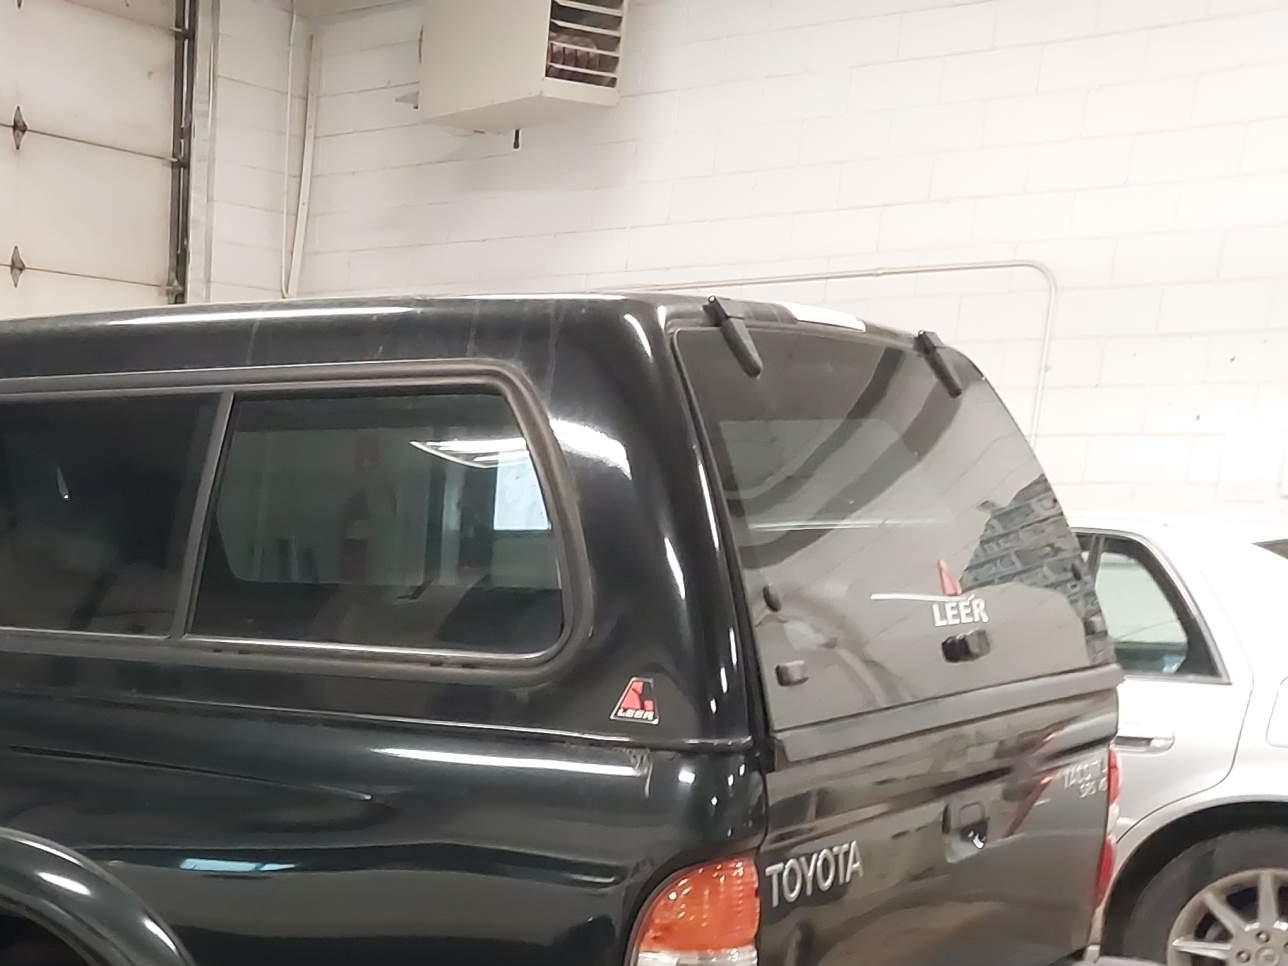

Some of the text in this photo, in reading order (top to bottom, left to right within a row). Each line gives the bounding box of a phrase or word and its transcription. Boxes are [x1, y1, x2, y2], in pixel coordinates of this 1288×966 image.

[932, 599, 989, 627] LEER
[616, 707, 655, 721] LEER
[765, 840, 864, 908] TOYOTA
